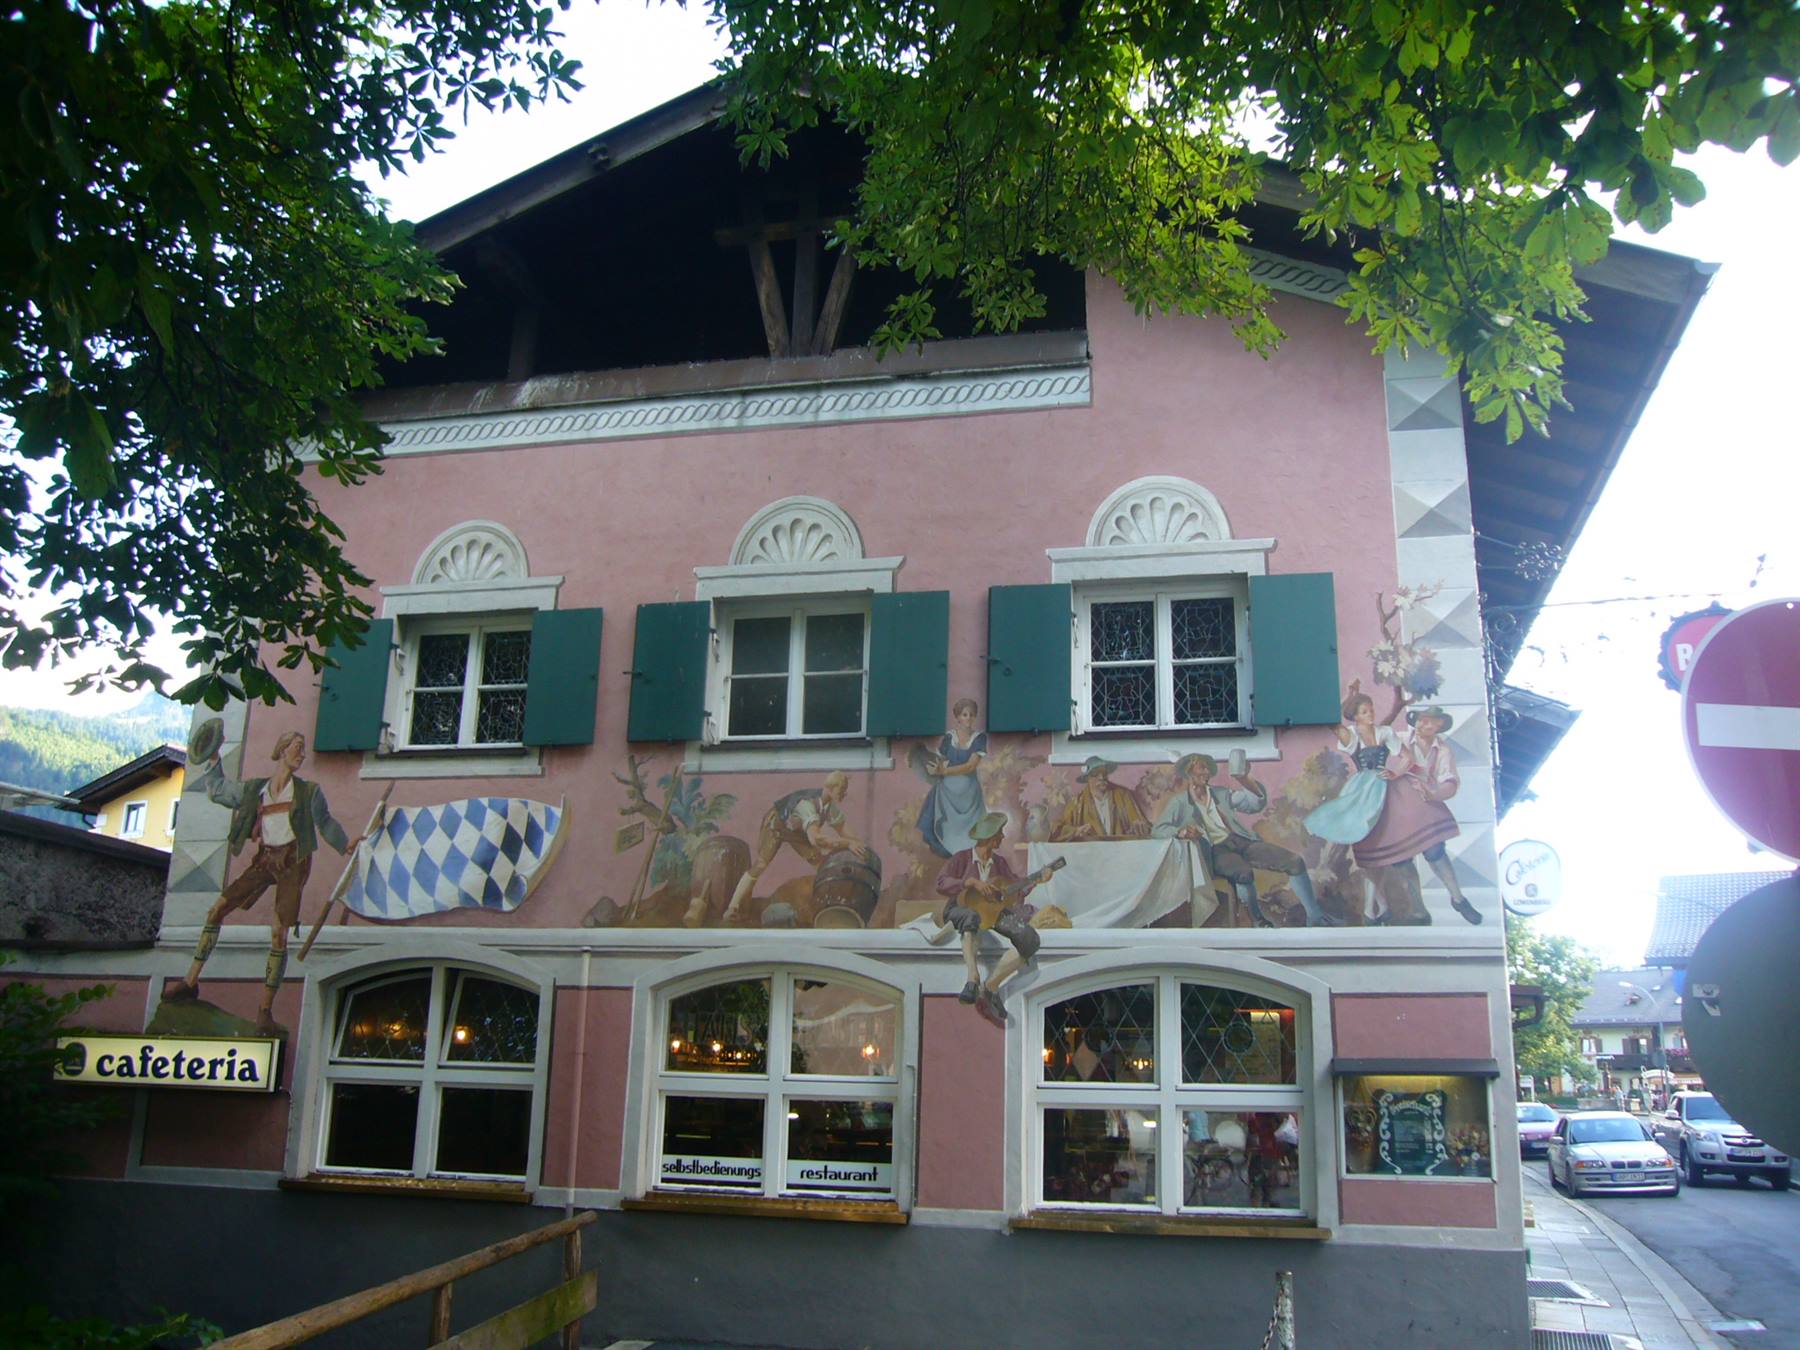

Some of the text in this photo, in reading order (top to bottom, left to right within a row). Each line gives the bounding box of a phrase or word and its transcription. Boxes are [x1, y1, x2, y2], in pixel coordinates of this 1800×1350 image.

[96, 1045, 260, 1082] cafeteria
[662, 1158, 879, 1182] selbstbedienungs restaurant
